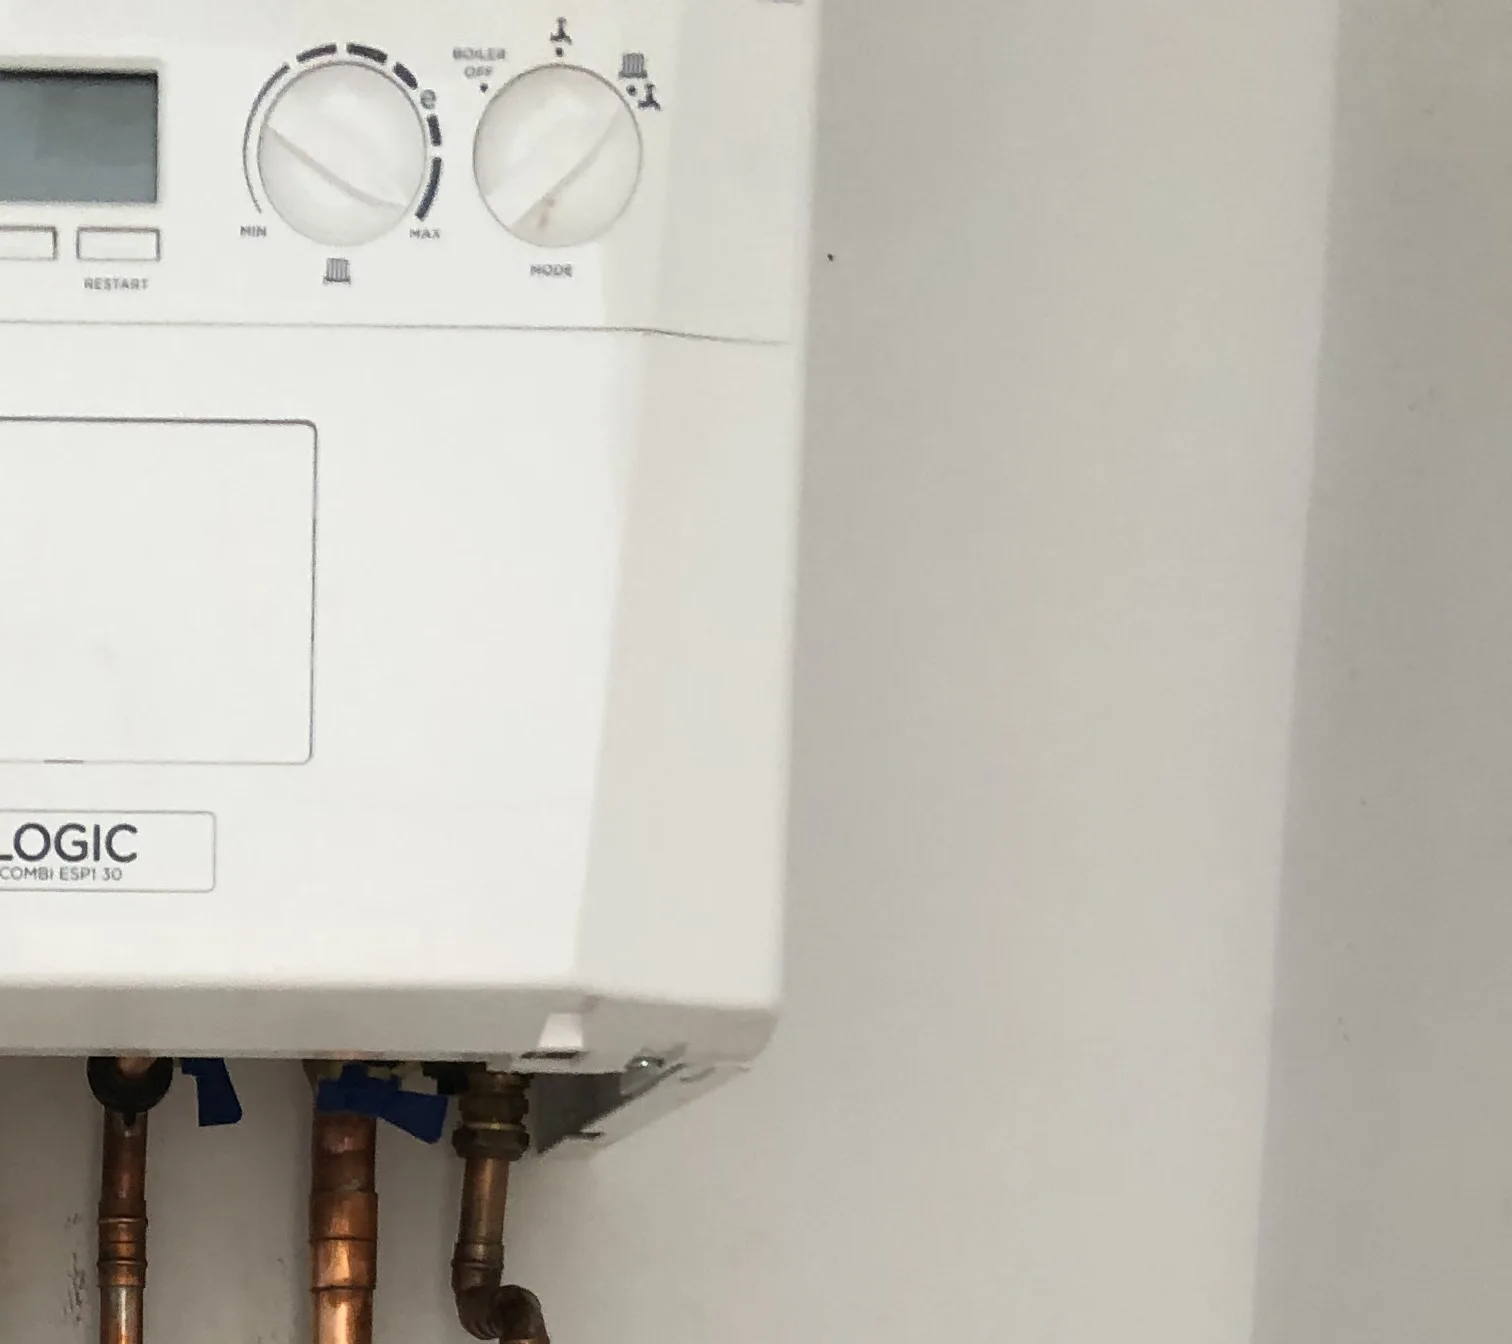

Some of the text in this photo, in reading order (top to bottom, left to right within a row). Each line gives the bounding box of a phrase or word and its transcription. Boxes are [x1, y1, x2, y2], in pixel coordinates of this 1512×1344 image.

[240, 225, 267, 237] MIN
[409, 228, 441, 240] MAX
[530, 263, 573, 278] MODE
[84, 277, 149, 291] RESTART
[102, 867, 123, 881] 30
